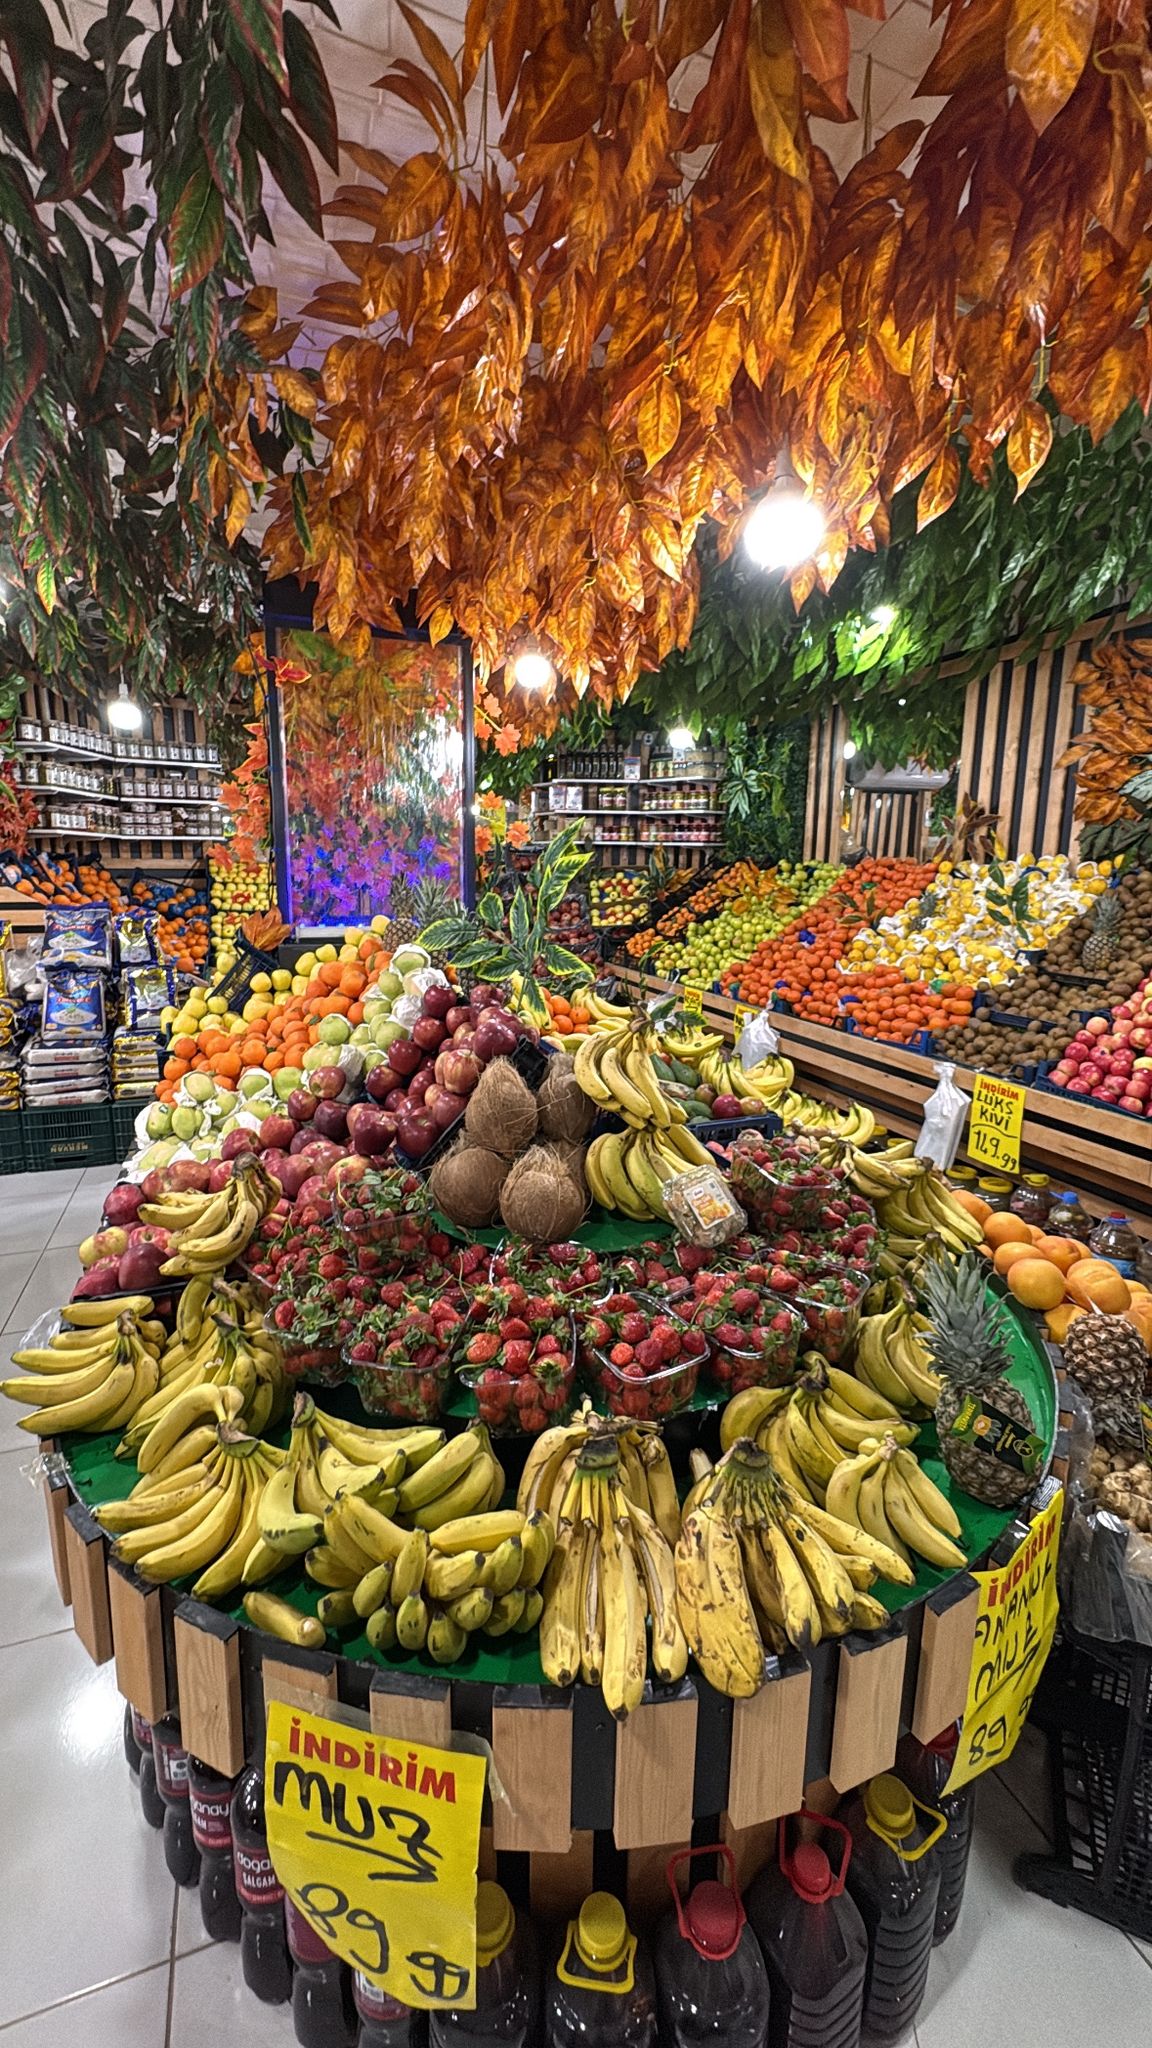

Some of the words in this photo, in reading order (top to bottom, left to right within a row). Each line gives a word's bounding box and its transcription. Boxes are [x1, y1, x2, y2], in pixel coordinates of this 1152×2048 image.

[987, 1514, 1057, 1608] İNDİRİM
[288, 1715, 457, 1804] İNDİRİM
[273, 1760, 445, 1873] MUZ
